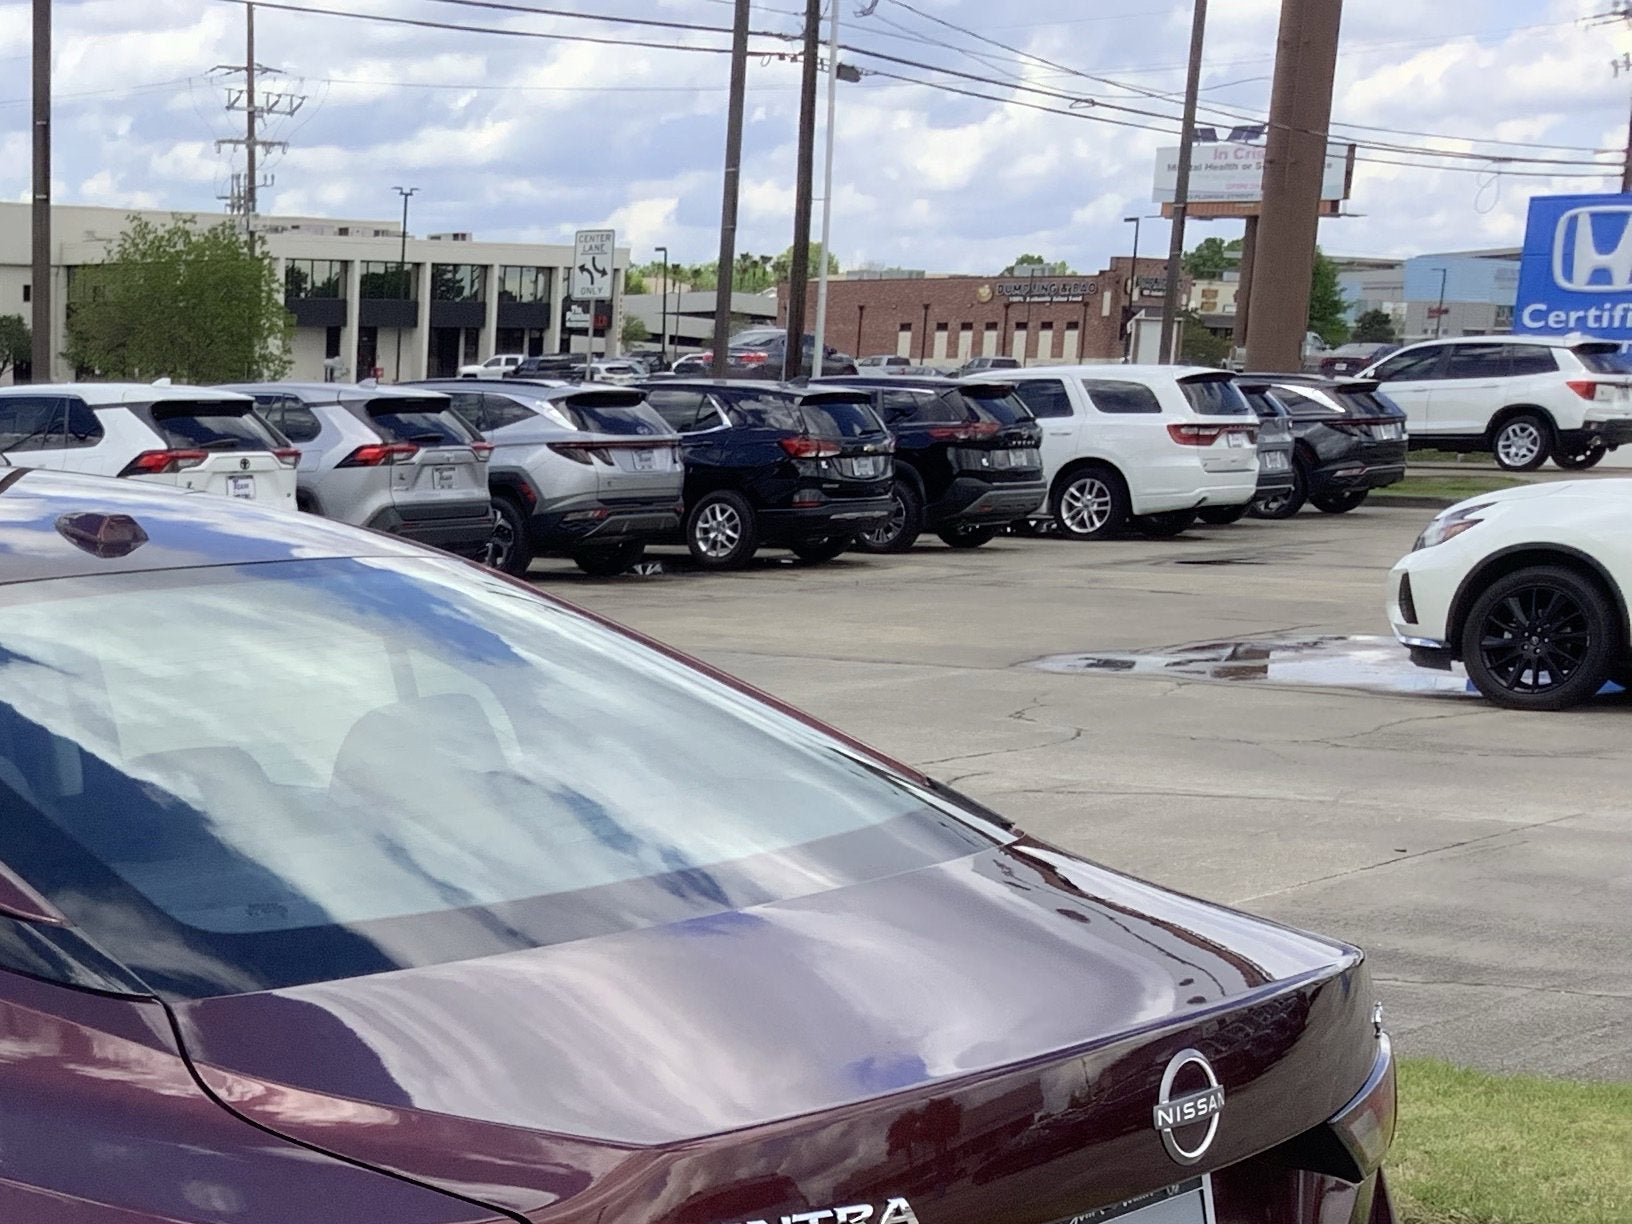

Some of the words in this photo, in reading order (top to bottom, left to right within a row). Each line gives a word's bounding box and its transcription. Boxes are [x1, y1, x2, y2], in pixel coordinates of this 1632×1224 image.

[1213, 147, 1228, 160] In
[1204, 163, 1239, 171] Health
[578, 234, 612, 243] CENTER
[583, 243, 606, 253] LANE
[580, 286, 603, 296] ONLY
[1071, 282, 1096, 295] BAO
[1157, 1092, 1225, 1127] NISSAN
